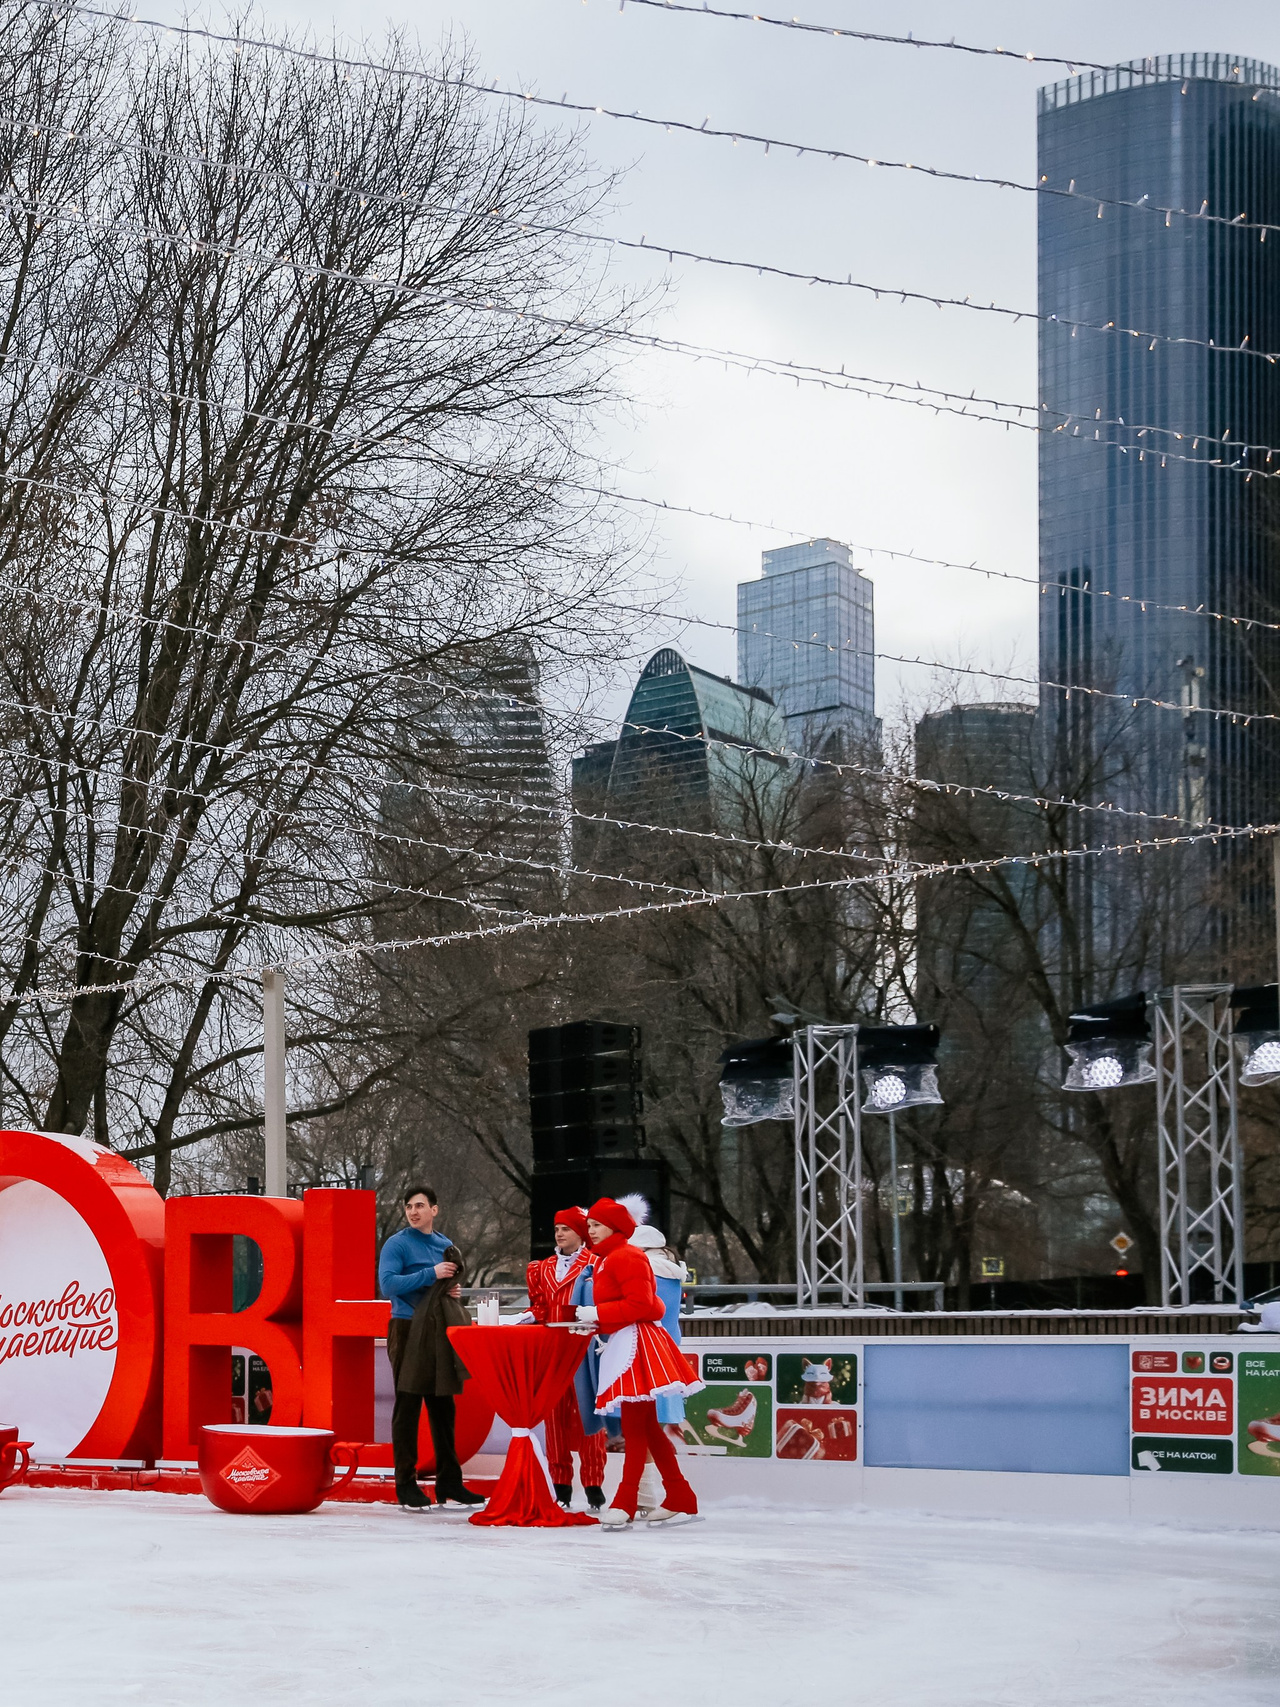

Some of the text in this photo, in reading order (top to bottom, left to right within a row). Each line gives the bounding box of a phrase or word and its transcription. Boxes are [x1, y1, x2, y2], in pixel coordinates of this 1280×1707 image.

[1245, 1360, 1266, 1368] ВСЕ
[1245, 1369, 1260, 1377] НА
[1139, 1386, 1227, 1408] ЗИМА
[1139, 1408, 1227, 1421] В МОСКВЕ
[1151, 1450, 1217, 1460] СЕ НА КАТОК!
